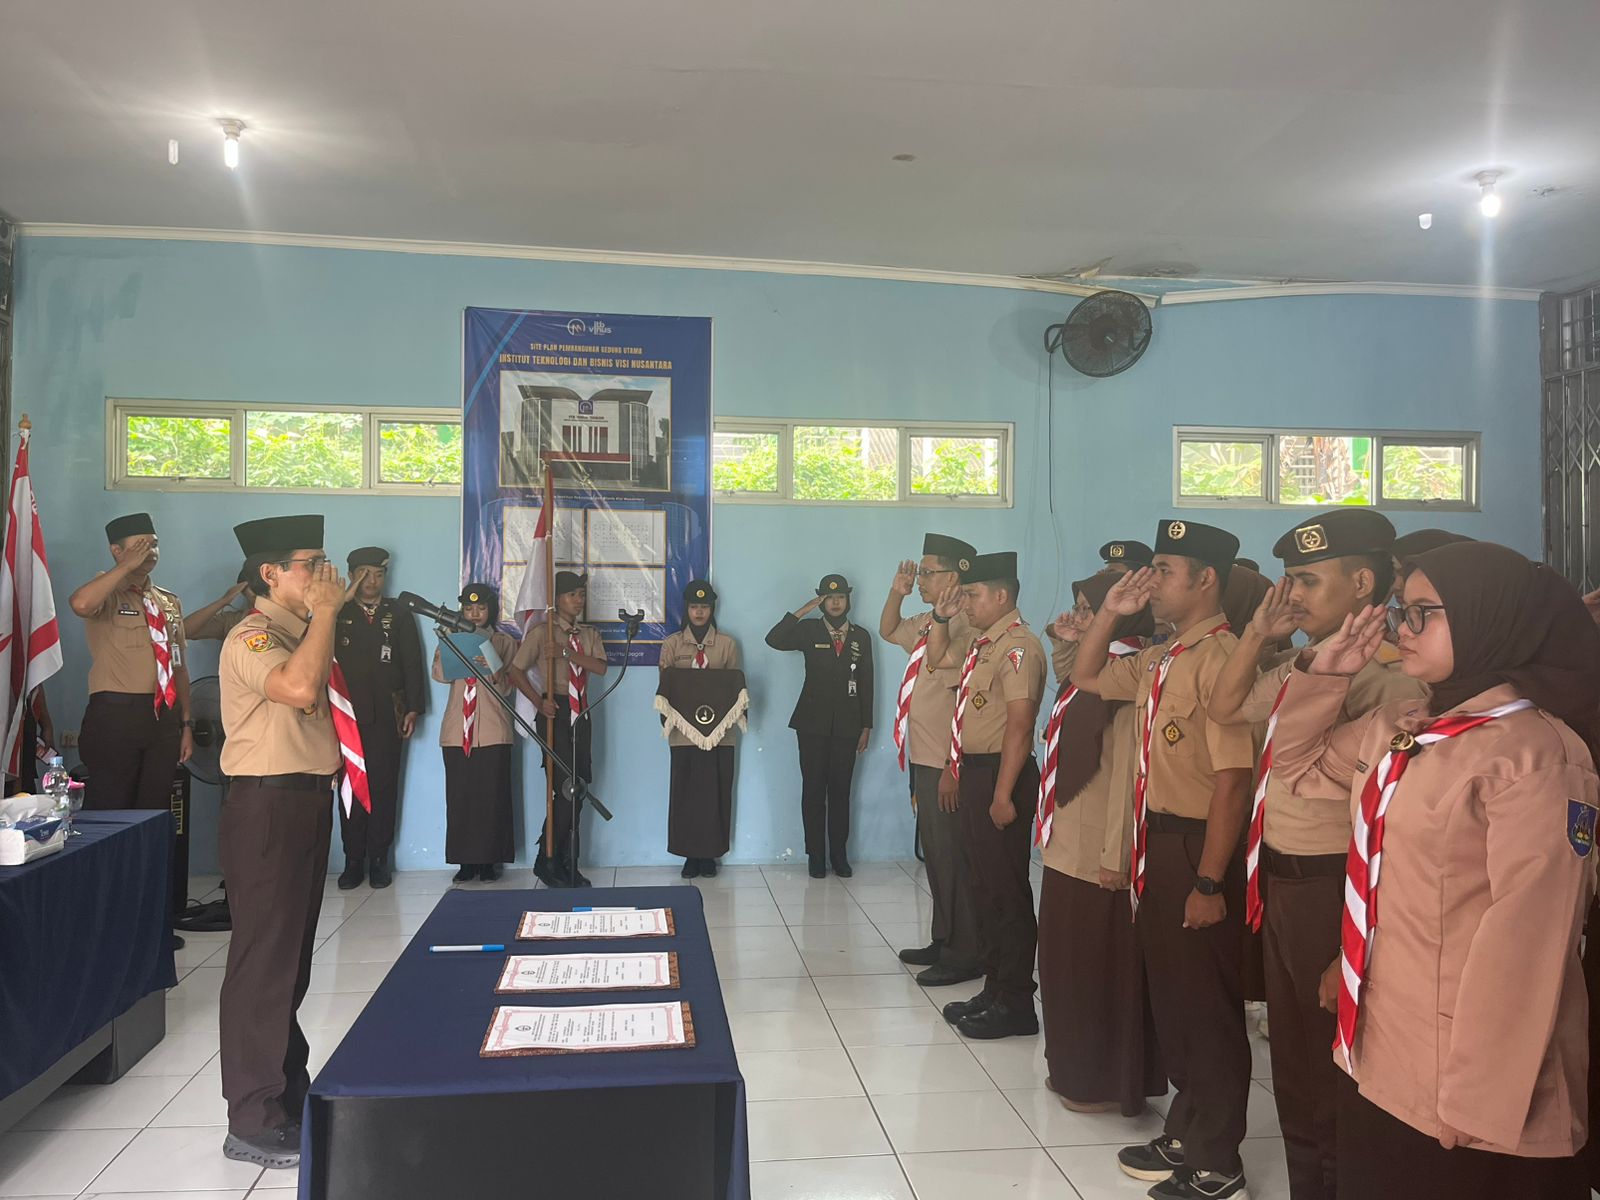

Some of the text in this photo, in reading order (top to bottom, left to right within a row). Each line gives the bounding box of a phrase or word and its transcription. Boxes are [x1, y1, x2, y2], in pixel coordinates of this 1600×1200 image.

[530, 343, 542, 351] SITE
[499, 353, 673, 370] INSTITUT TEKNOLOGI DAN BISNIS VISI NUSANTARA
